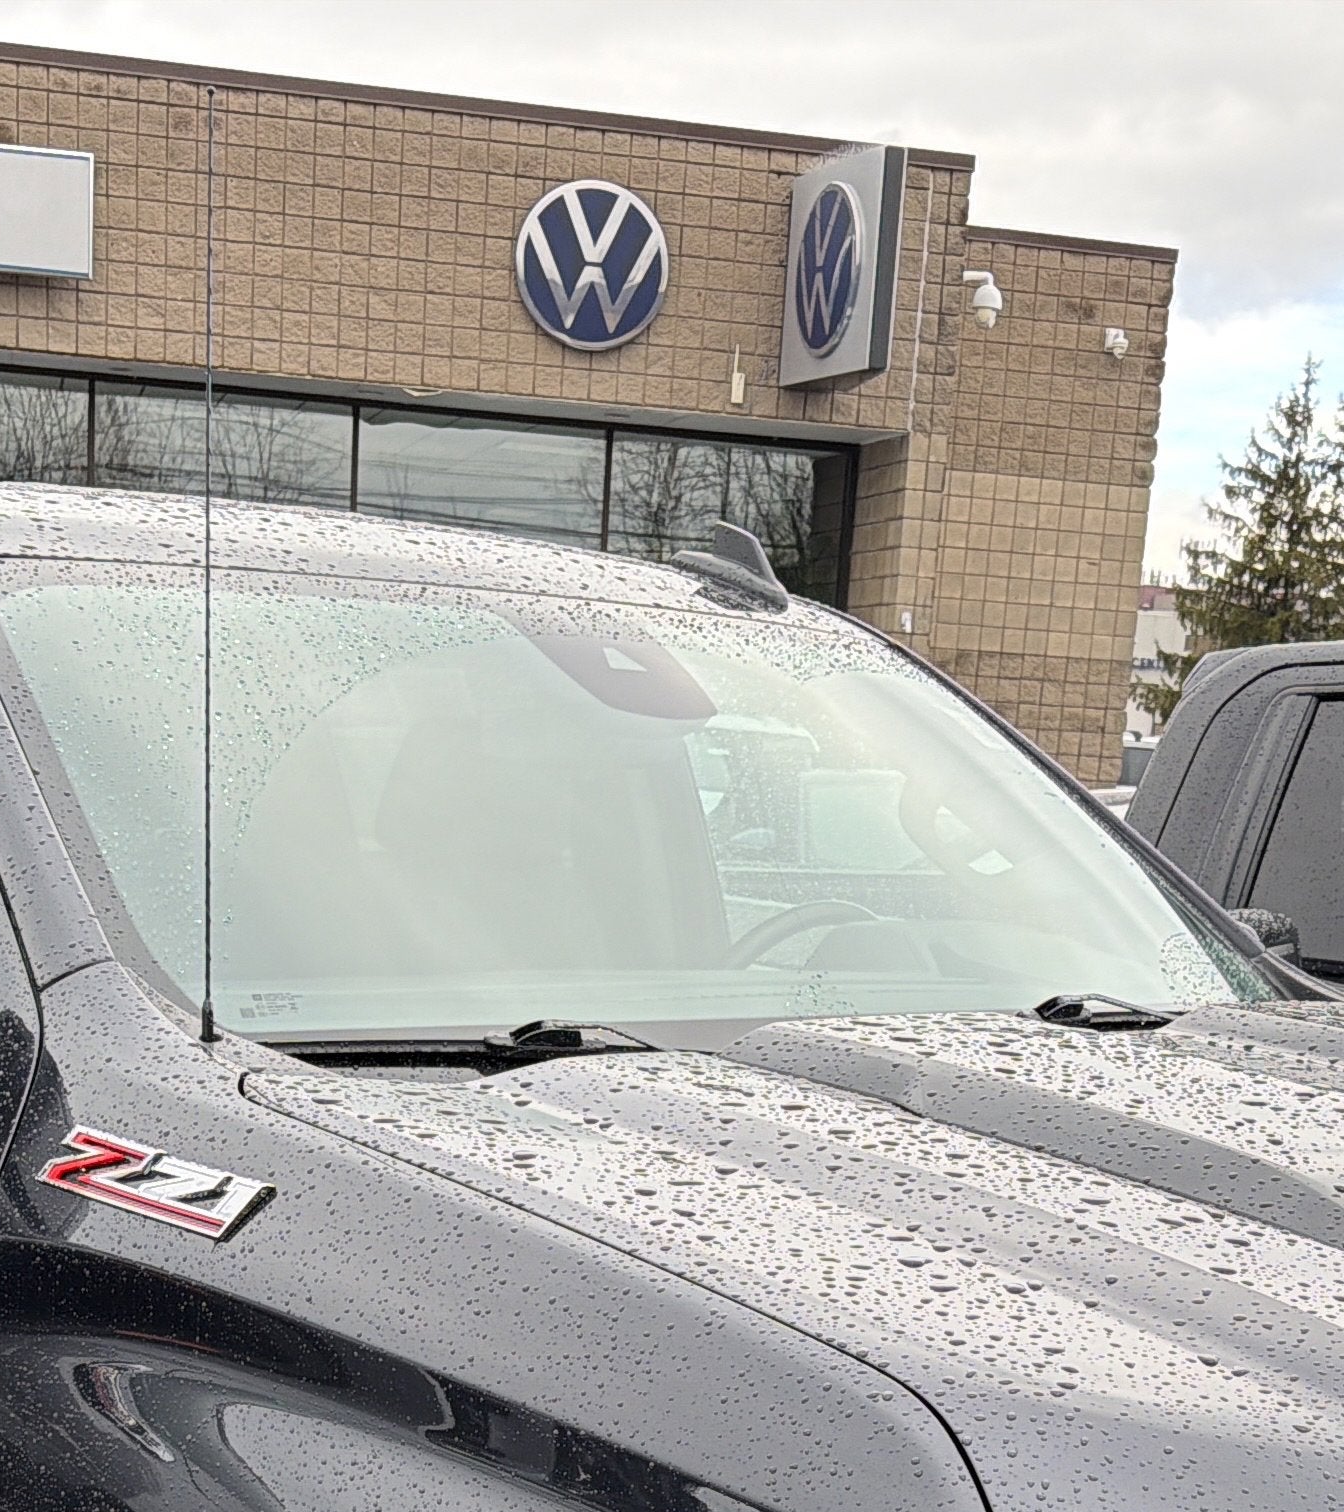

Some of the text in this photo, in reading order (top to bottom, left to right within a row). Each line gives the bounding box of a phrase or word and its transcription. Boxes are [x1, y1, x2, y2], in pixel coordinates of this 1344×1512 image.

[528, 186, 662, 334] VW
[799, 186, 856, 340] VW
[35, 1124, 277, 1240] Z71
